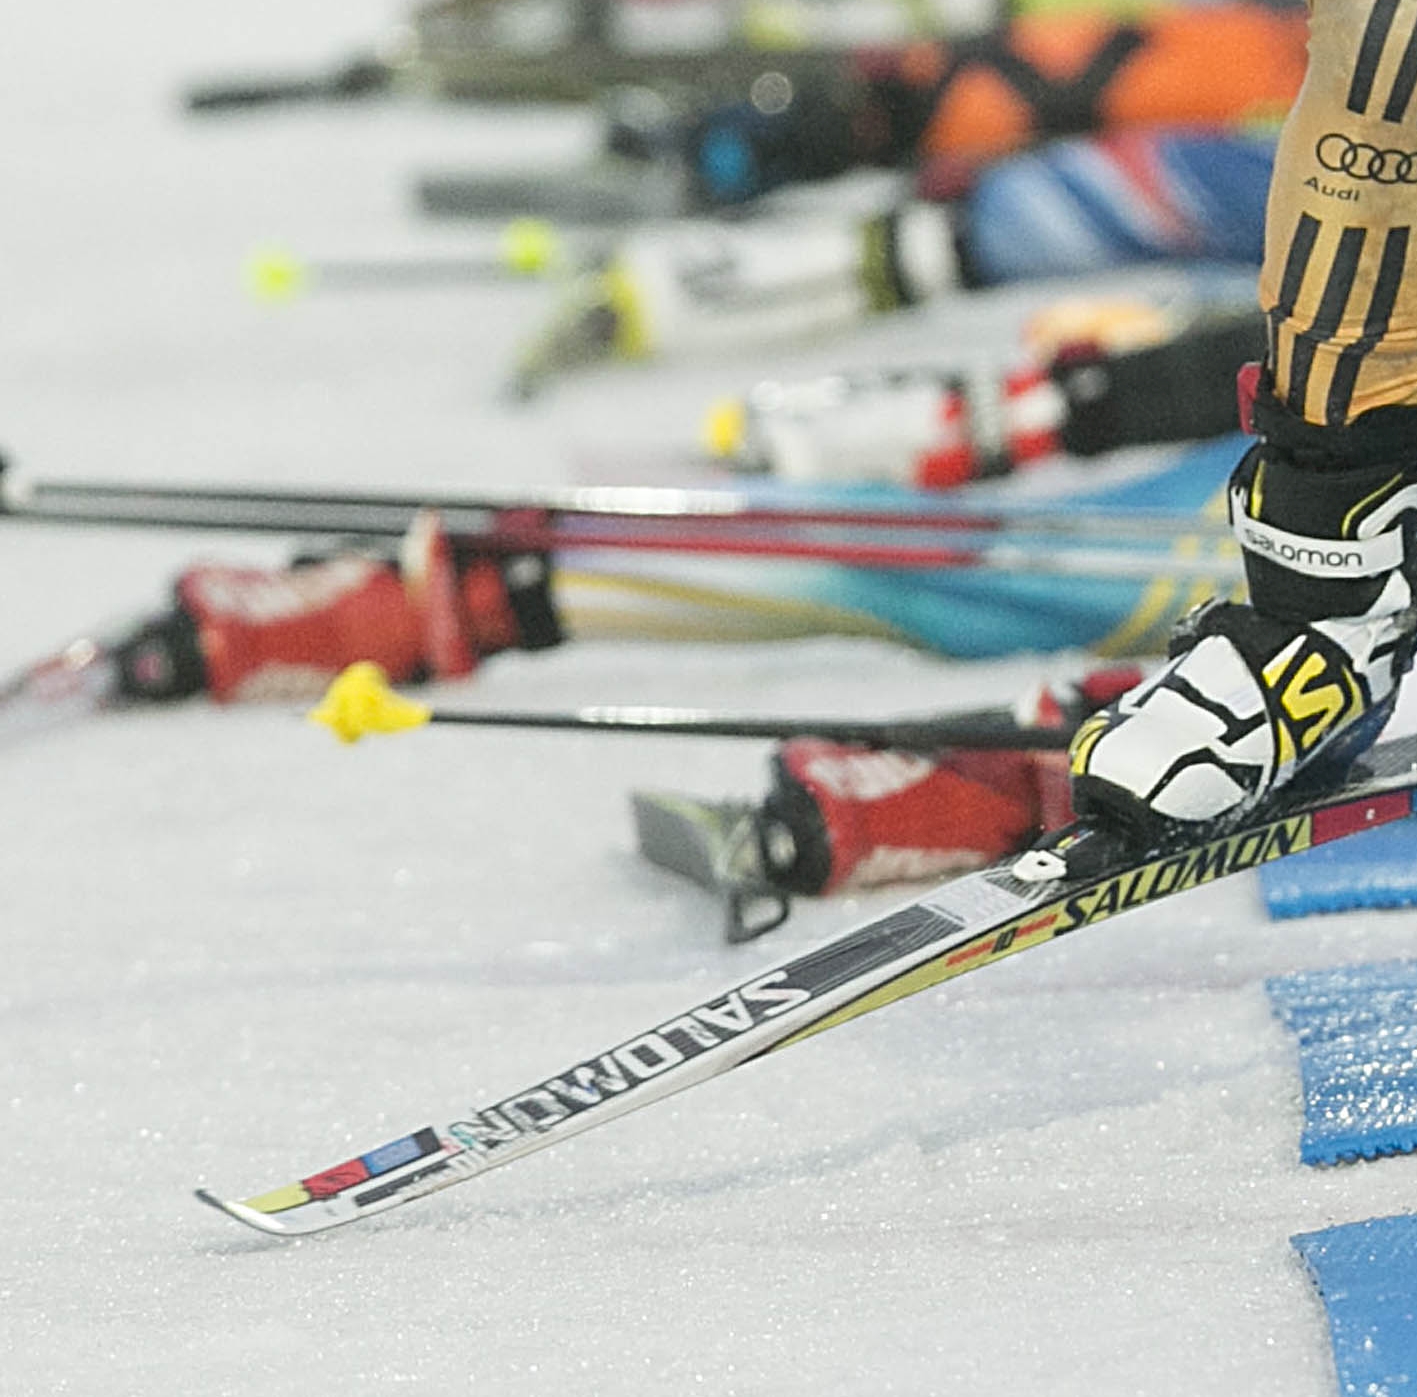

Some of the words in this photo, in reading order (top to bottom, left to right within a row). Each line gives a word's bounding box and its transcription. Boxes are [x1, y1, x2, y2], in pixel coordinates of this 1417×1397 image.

[1303, 176, 1360, 202] Audi
[1053, 814, 1305, 937] SALOMON
[448, 969, 813, 1150] SALOMON
